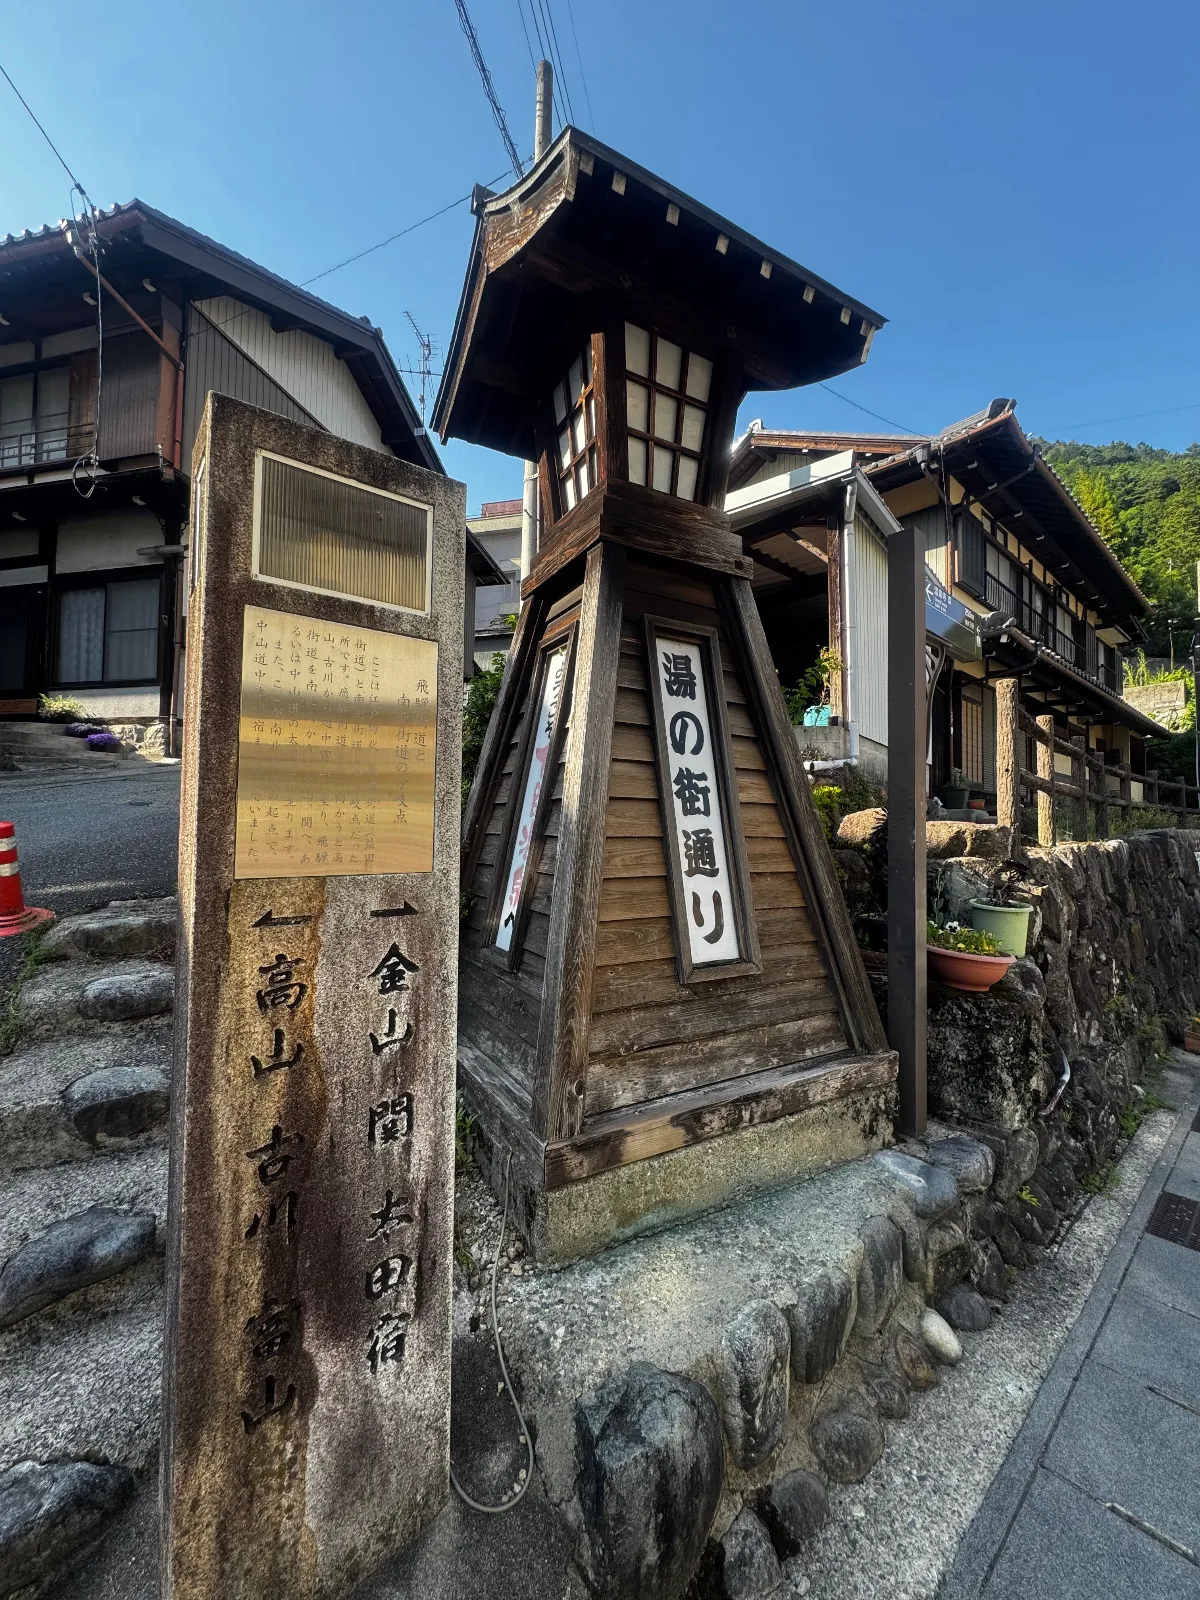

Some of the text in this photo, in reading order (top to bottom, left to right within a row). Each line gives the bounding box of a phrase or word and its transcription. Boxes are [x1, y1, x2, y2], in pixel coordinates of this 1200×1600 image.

[662, 651, 725, 944] 湯の街通り
[251, 953, 308, 1079] 高山
[367, 942, 420, 1055] 金山
[245, 1124, 304, 1245] 古川
